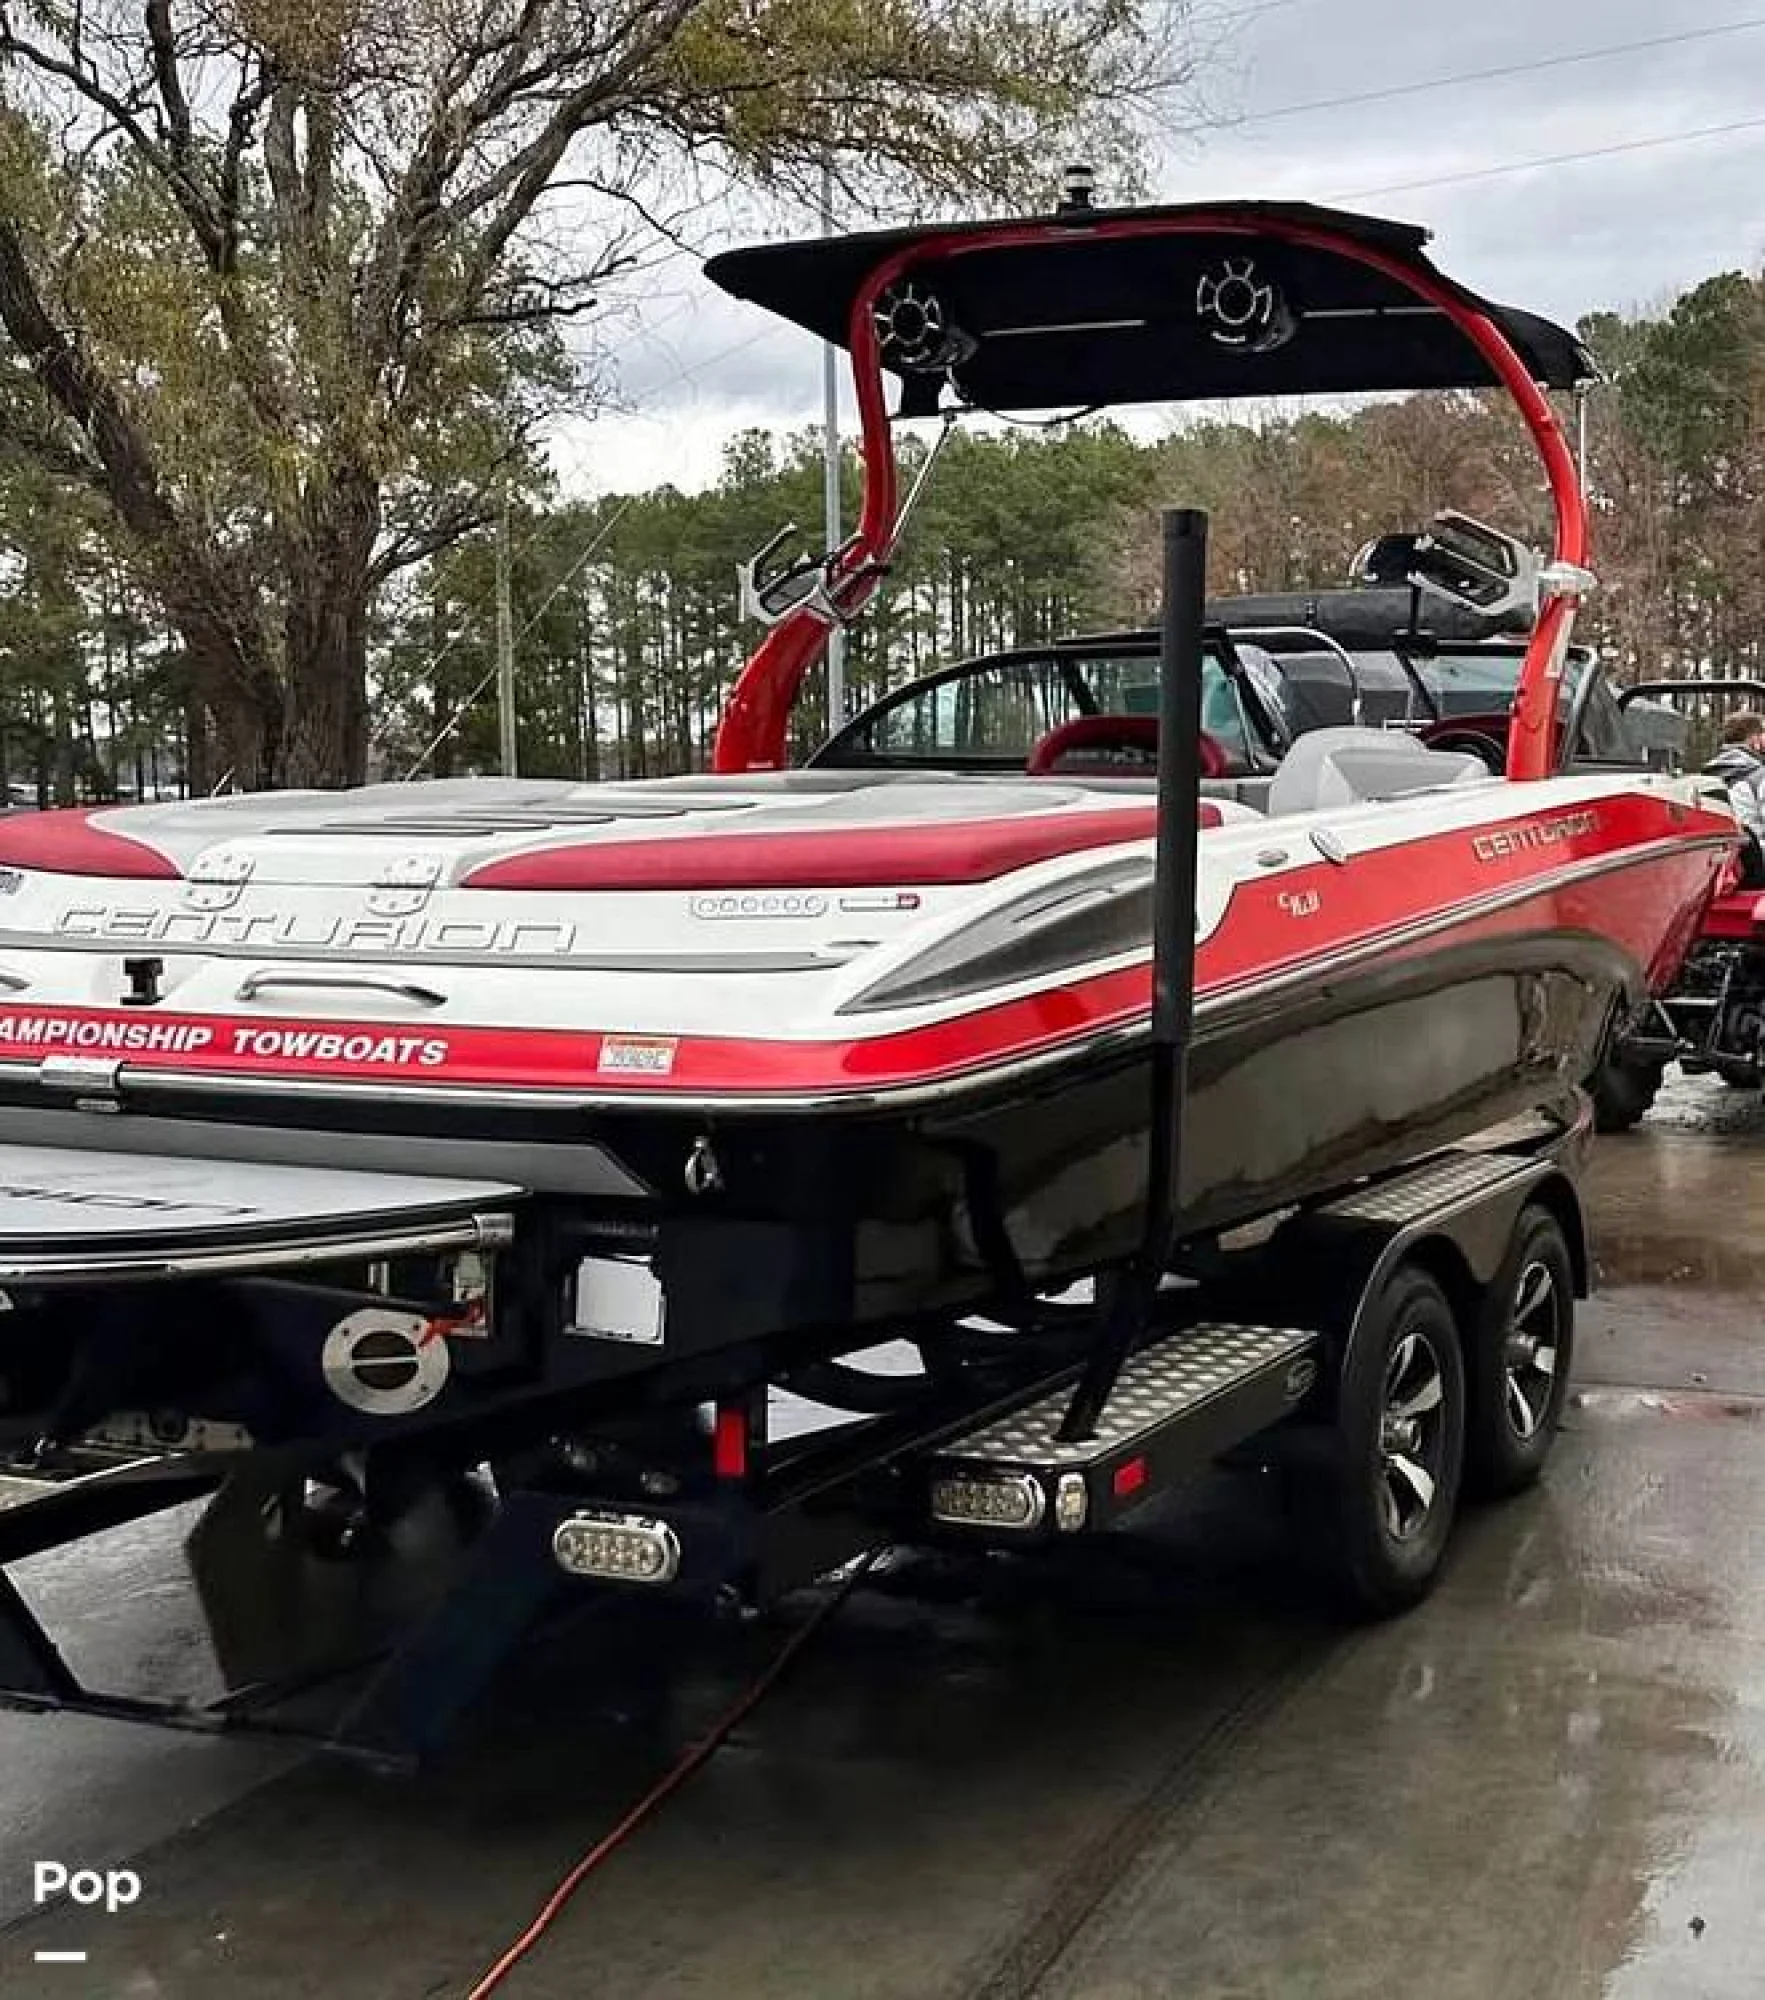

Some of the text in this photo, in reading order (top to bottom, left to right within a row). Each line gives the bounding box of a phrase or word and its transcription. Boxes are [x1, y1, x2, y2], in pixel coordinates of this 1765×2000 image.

[58, 906, 577, 953] CENTURION
[0, 1016, 449, 1065] AMPIONSHIP TOWBOATS
